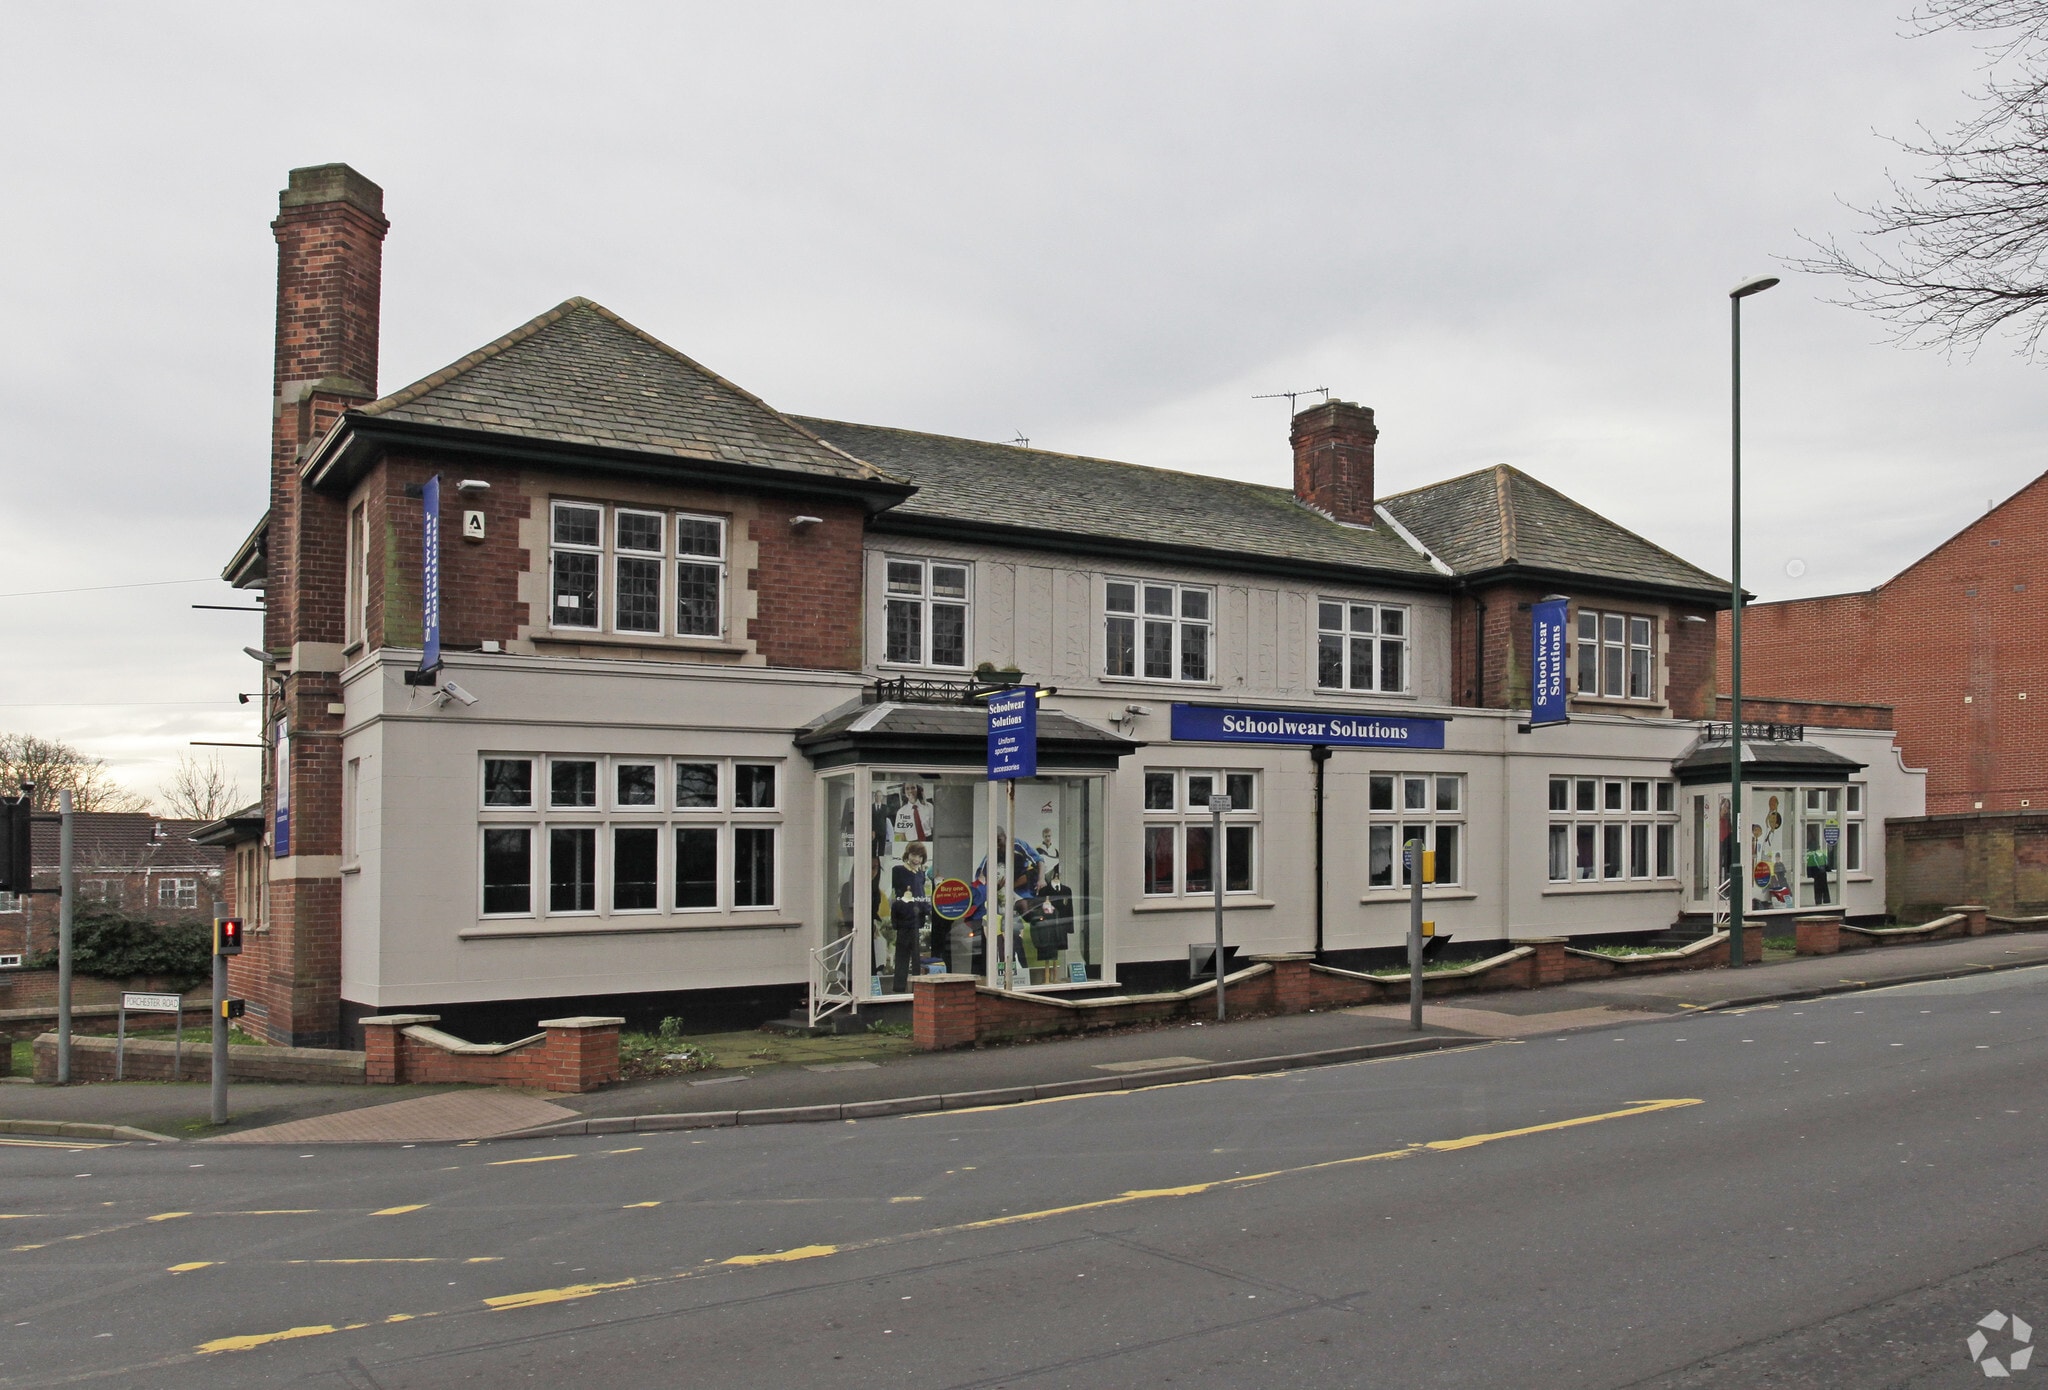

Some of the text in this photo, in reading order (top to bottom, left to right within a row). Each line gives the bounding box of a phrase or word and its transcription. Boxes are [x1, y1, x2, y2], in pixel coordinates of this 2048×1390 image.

[1537, 622, 1548, 706] Schoolwear
[1550, 625, 1560, 696] Solutions
[989, 700, 1024, 714] Schoolwear
[992, 715, 1022, 728] Solutions
[1222, 715, 1408, 739] Schoolwear Solutions
[998, 737, 1016, 745] Uniform
[994, 746, 1019, 756] sportswear
[994, 764, 1020, 773] accessories
[126, 996, 178, 1008] PORCHESTER ROAD
